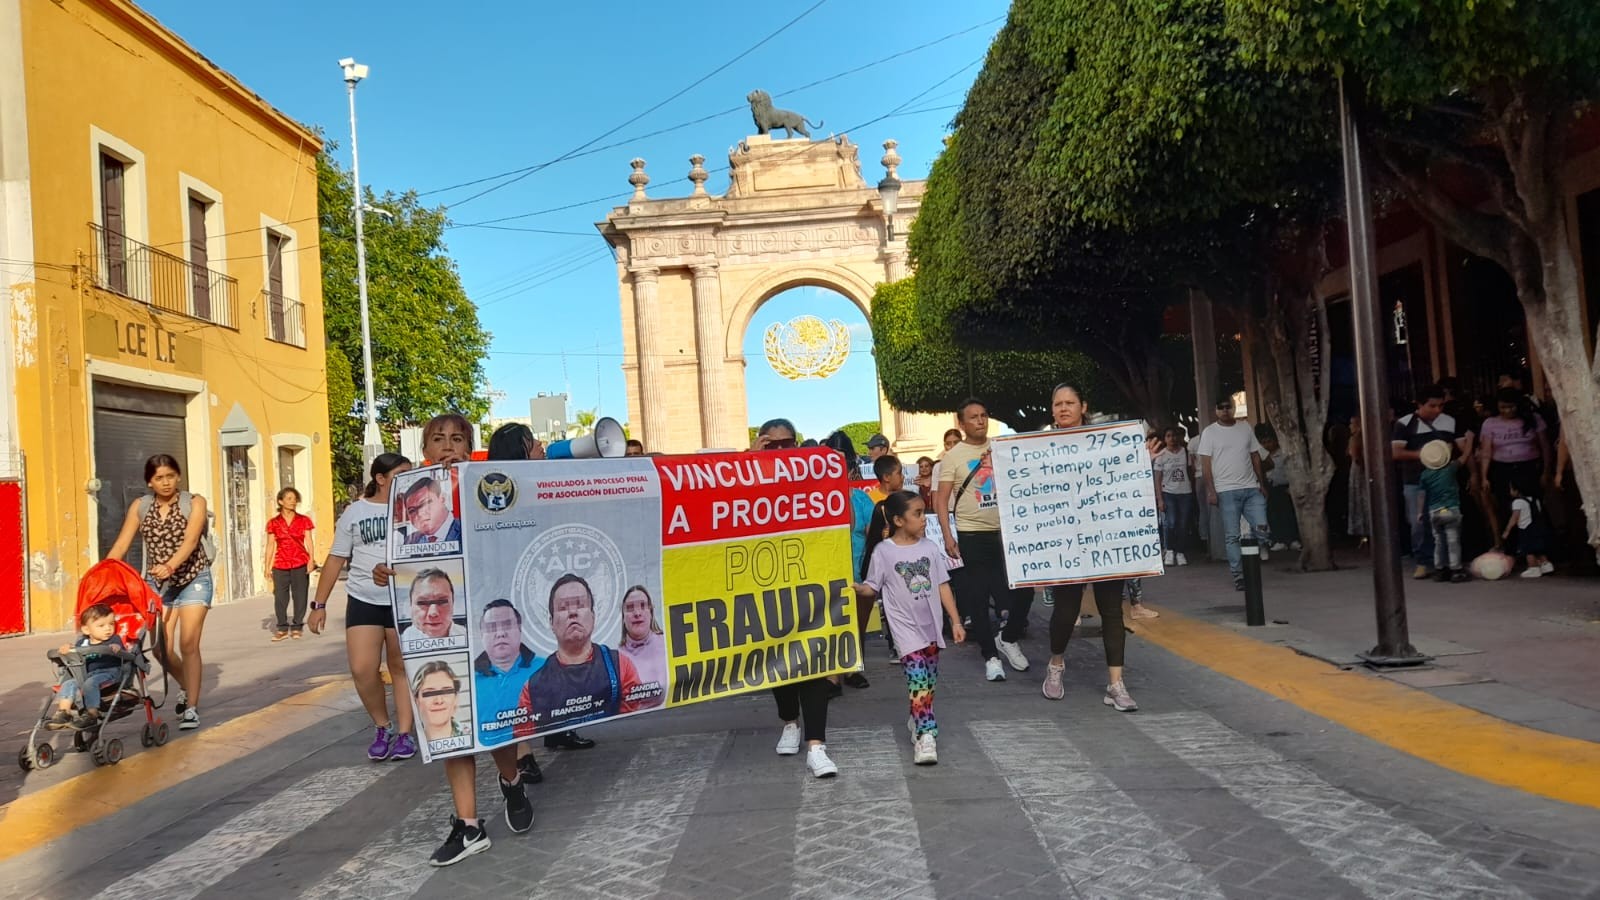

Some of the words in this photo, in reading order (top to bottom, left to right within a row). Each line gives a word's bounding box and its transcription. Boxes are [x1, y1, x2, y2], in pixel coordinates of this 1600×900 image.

[1011, 442, 1079, 462] Proximo
[1086, 432, 1107, 451] 27
[661, 453, 843, 491] VINCULADOS
[1007, 467, 1030, 480] es
[1040, 460, 1093, 476] tiempo
[1099, 455, 1121, 472] que
[1126, 449, 1138, 464] el
[537, 479, 585, 488] VINCULADOS
[594, 477, 624, 485] PROCESO
[627, 475, 648, 483] PENAL
[538, 491, 553, 499] POR
[555, 488, 600, 498] ASOCIACIÓN
[603, 486, 644, 495] DELICTUOSA
[1009, 482, 1070, 499] Gobierno
[1076, 481, 1083, 493] y
[1086, 474, 1103, 486] los
[1106, 469, 1152, 485] Jueces
[668, 505, 690, 534] A
[712, 490, 845, 530] PROCESO
[1011, 503, 1027, 518] le
[1034, 501, 1069, 515] hagan
[1077, 490, 1128, 510] justicia
[1132, 490, 1142, 499] a
[1013, 524, 1029, 534] su
[1091, 506, 1133, 522] basta
[1138, 507, 1156, 518] de
[399, 543, 446, 554] FERNANDO
[449, 542, 456, 551] N
[1008, 537, 1062, 556] Amparos
[1066, 537, 1073, 548] y
[545, 552, 592, 574] AIC
[725, 538, 807, 591] POR
[1022, 560, 1052, 577] para
[1060, 553, 1081, 569] los
[669, 578, 850, 658] FRAUDE
[408, 638, 446, 651] EDGAR
[449, 638, 456, 647] N
[671, 630, 857, 704] MILLONARIO
[631, 682, 659, 693] SANDRA
[551, 702, 592, 718] FRANCISCO
[566, 695, 593, 706] EDGAR
[481, 716, 528, 731] FERNANDO
[496, 706, 528, 720] CARLOS
[459, 737, 465, 746] N
